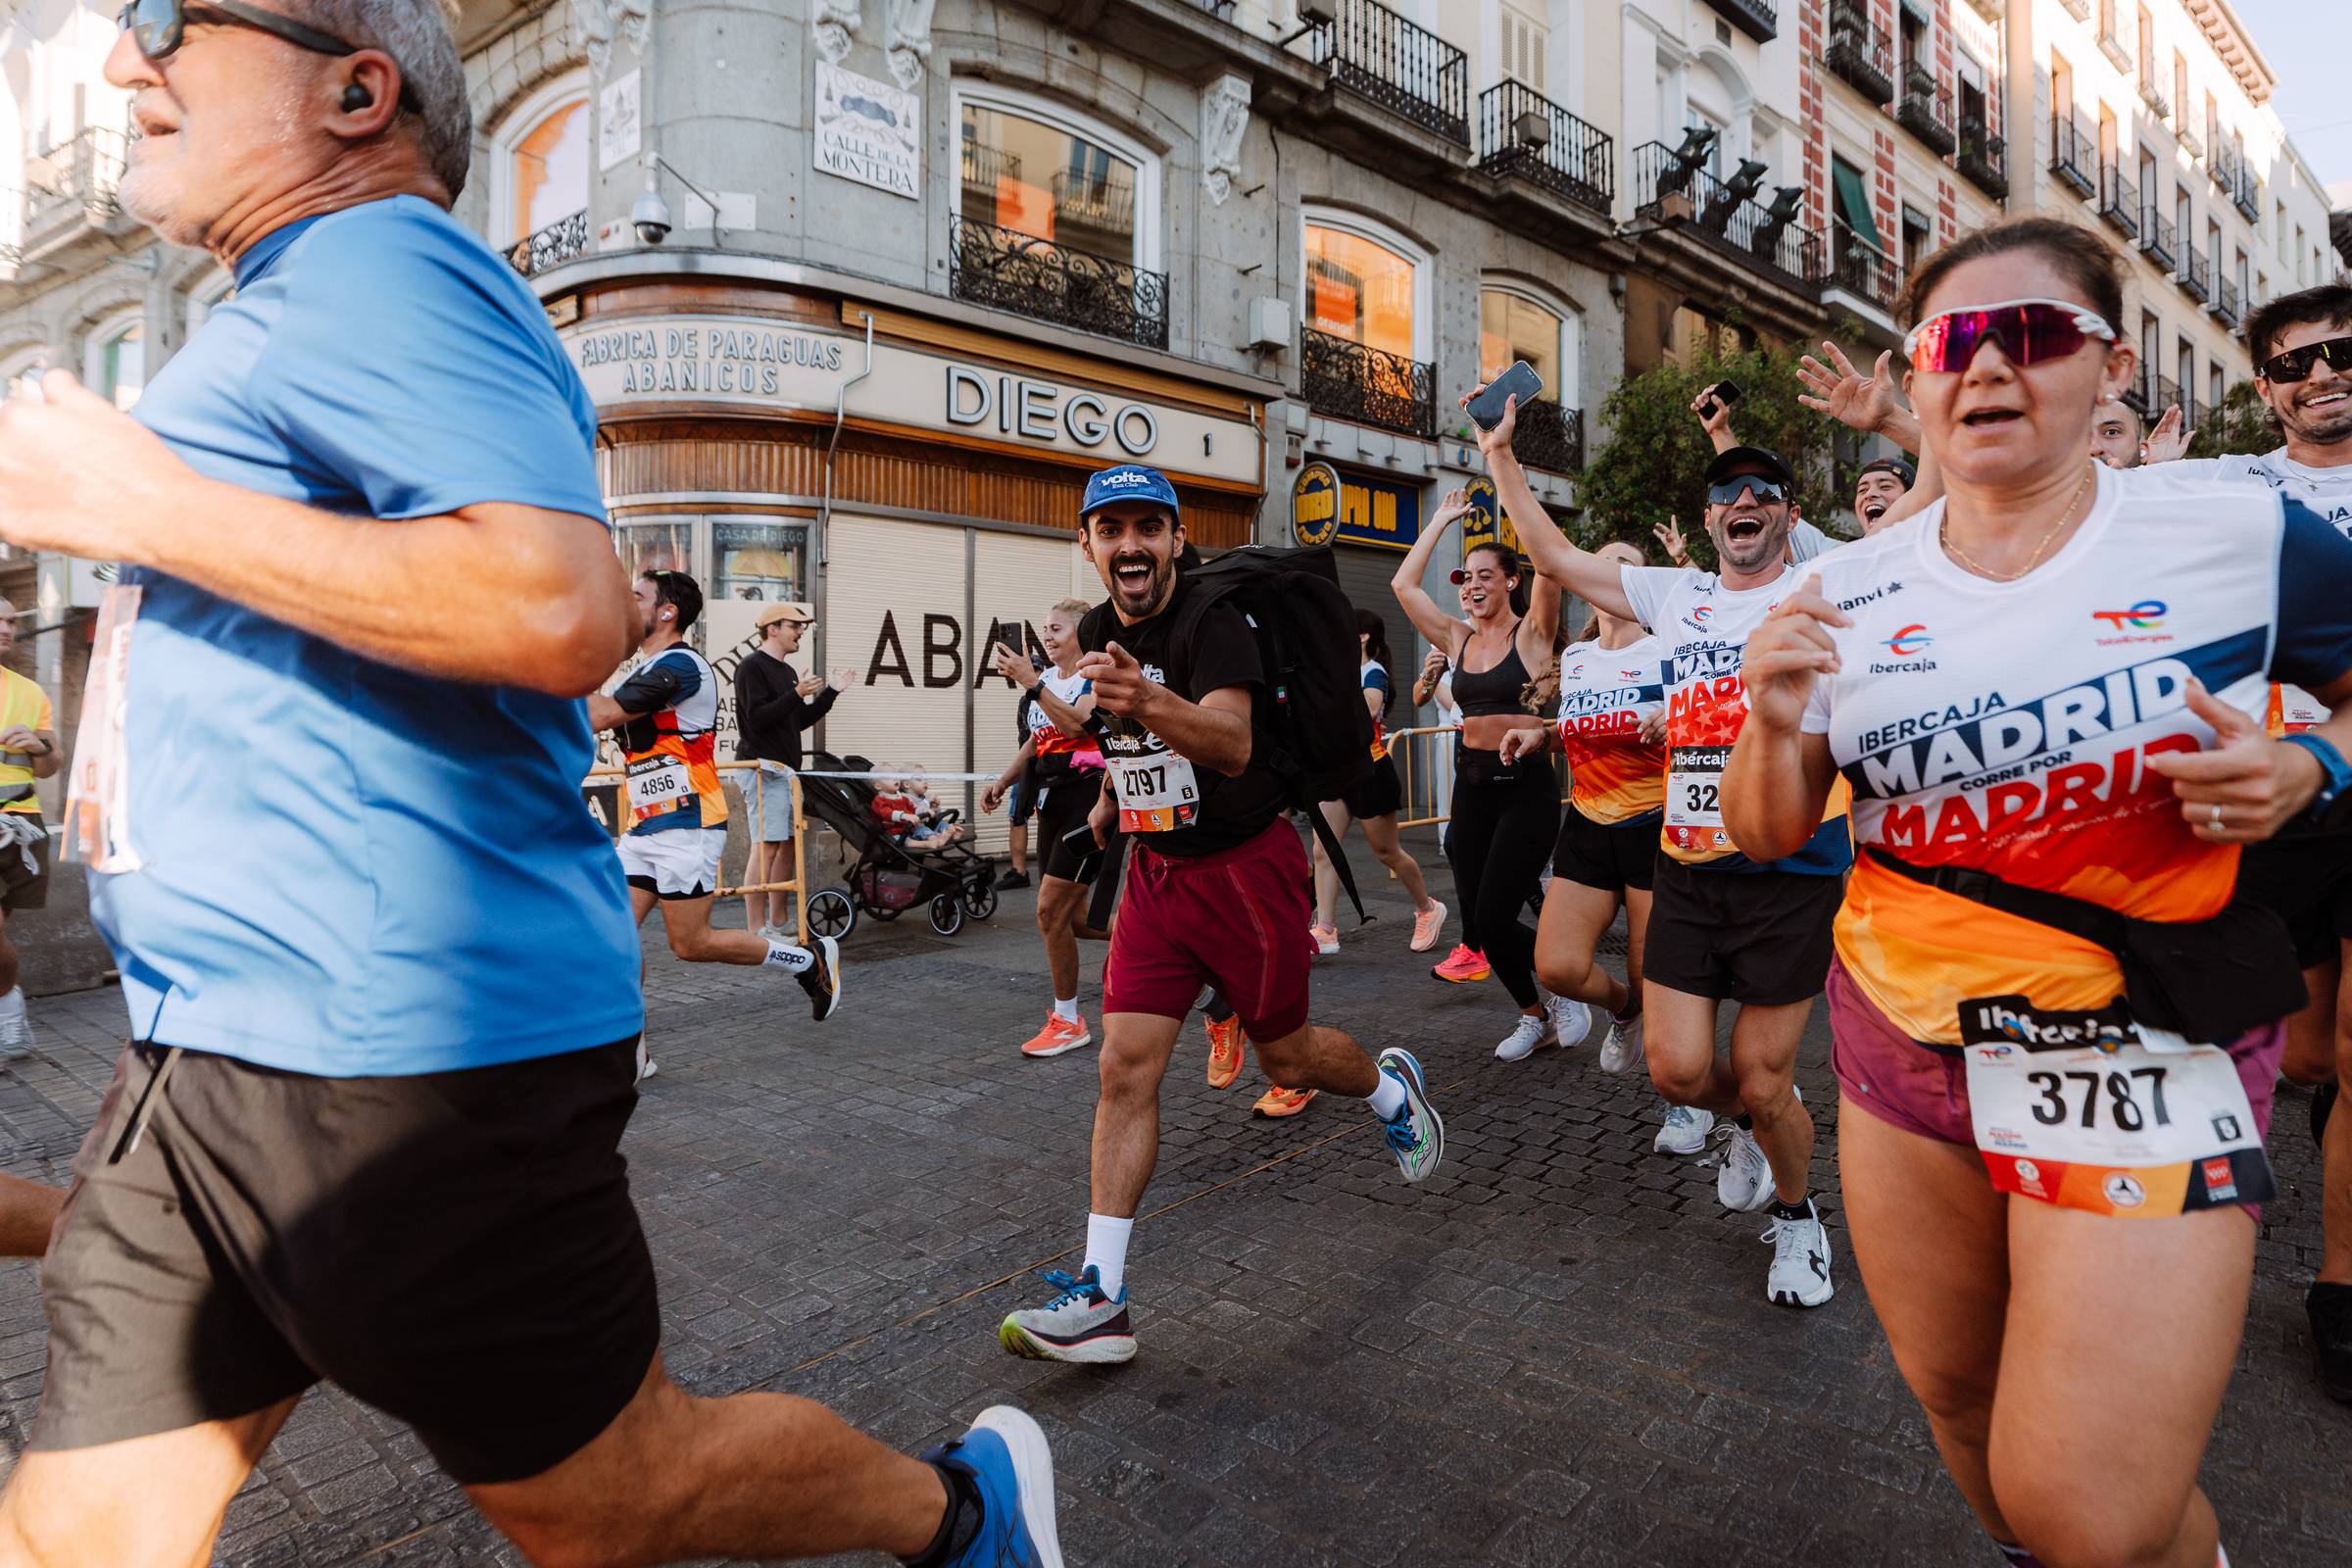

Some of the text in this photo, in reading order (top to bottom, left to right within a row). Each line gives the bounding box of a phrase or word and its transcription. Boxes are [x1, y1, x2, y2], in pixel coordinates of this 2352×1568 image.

[824, 131, 910, 169] CALLE DE LA
[823, 148, 913, 192] MONTERA
[580, 328, 842, 370] FABRICA DE PARAGUAS
[622, 361, 778, 394] ABANICOS
[947, 366, 1158, 456] DIEGO
[1203, 432, 1212, 457] 1
[1102, 471, 1151, 487] volta
[1298, 470, 1330, 493] COMPRO
[1297, 489, 1333, 523] ORO
[716, 528, 804, 542] CASA DE DIEGO
[1682, 616, 1709, 634] Ibercaja
[1673, 646, 1747, 685] MAD
[1704, 668, 1733, 680] CORRE
[1868, 658, 1936, 674] Ibercaja
[1668, 676, 1746, 720] MAD
[1858, 691, 2007, 755] IBERCAJA
[1862, 658, 2195, 799] MADRID
[629, 758, 660, 774] Ibercaja
[1122, 764, 1167, 797] 2797
[1960, 751, 2073, 792] CORRE POR
[641, 774, 675, 796] 4856
[1184, 788, 1192, 798] 5
[2028, 1067, 2171, 1133] 3787
